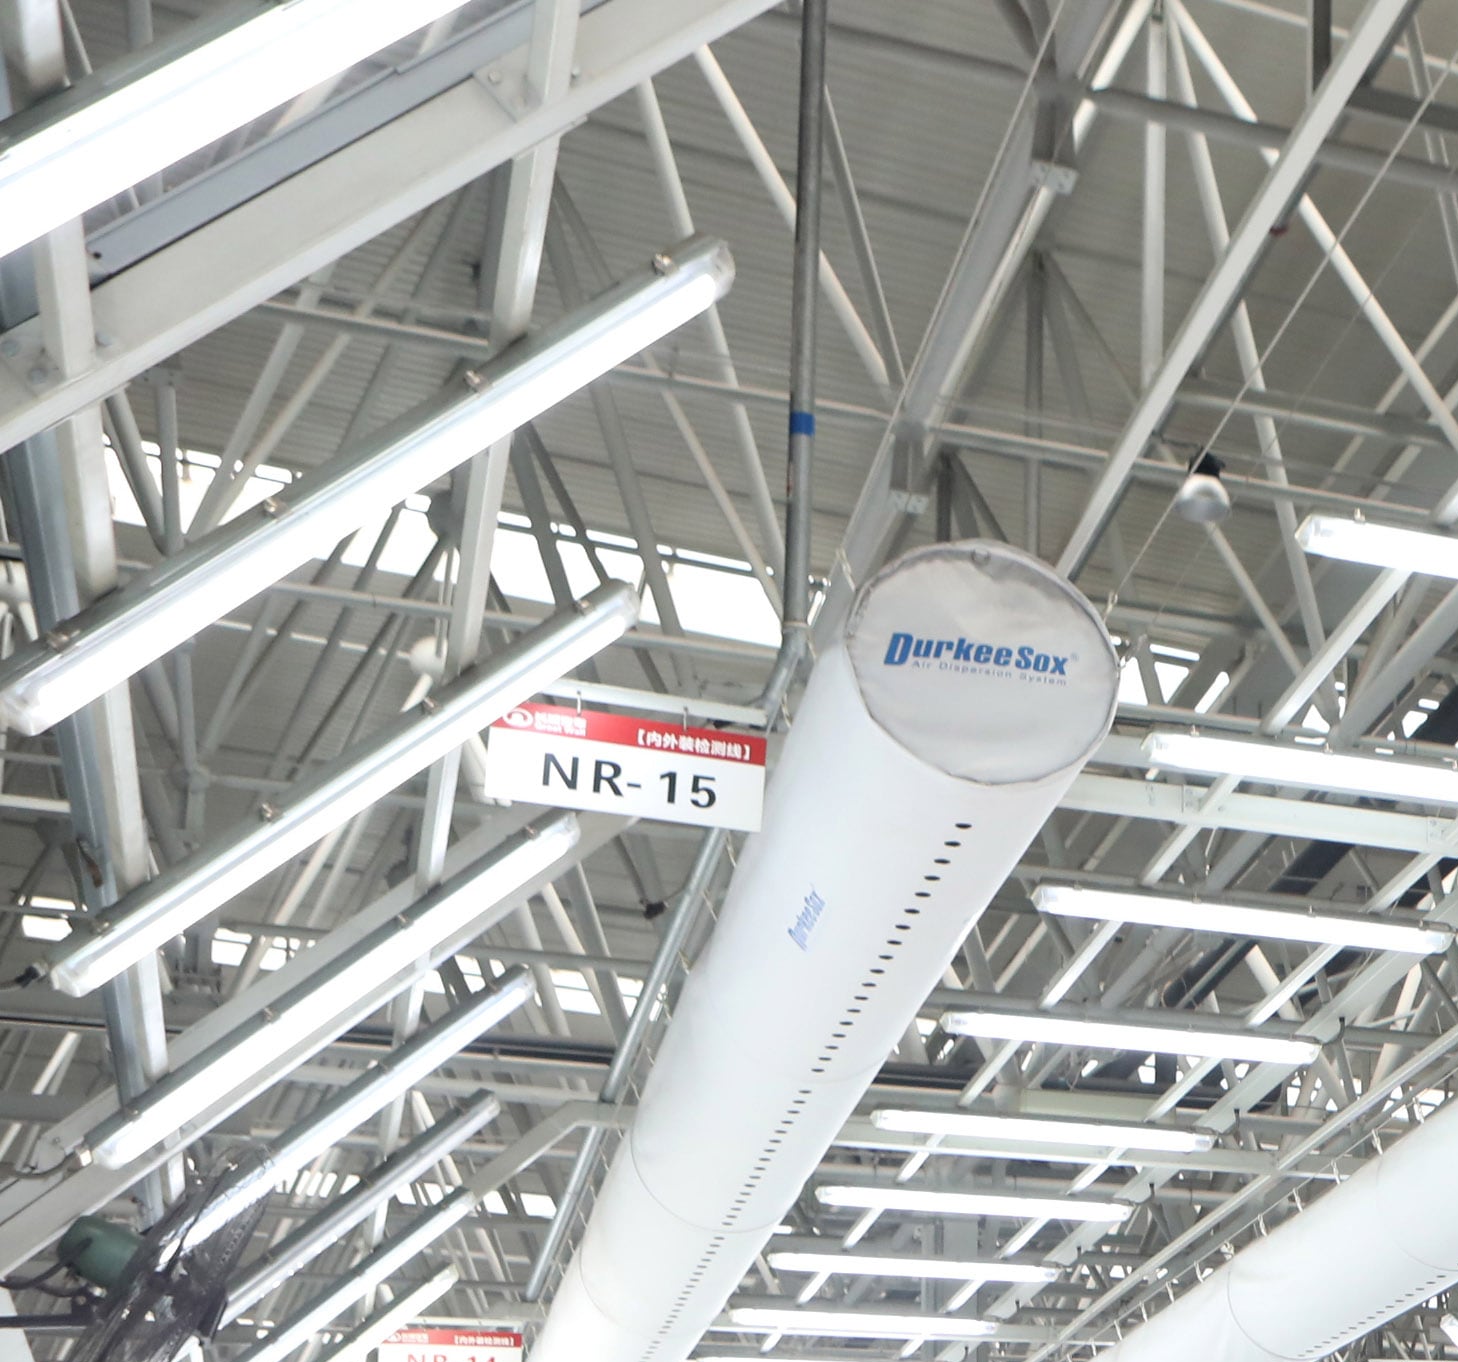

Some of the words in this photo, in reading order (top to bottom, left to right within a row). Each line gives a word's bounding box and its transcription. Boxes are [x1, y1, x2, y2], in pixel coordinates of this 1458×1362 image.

[884, 632, 1069, 675] DurkeeSox
[911, 660, 931, 670] Air
[938, 661, 1012, 679] Dispersion
[1018, 673, 1067, 686] System
